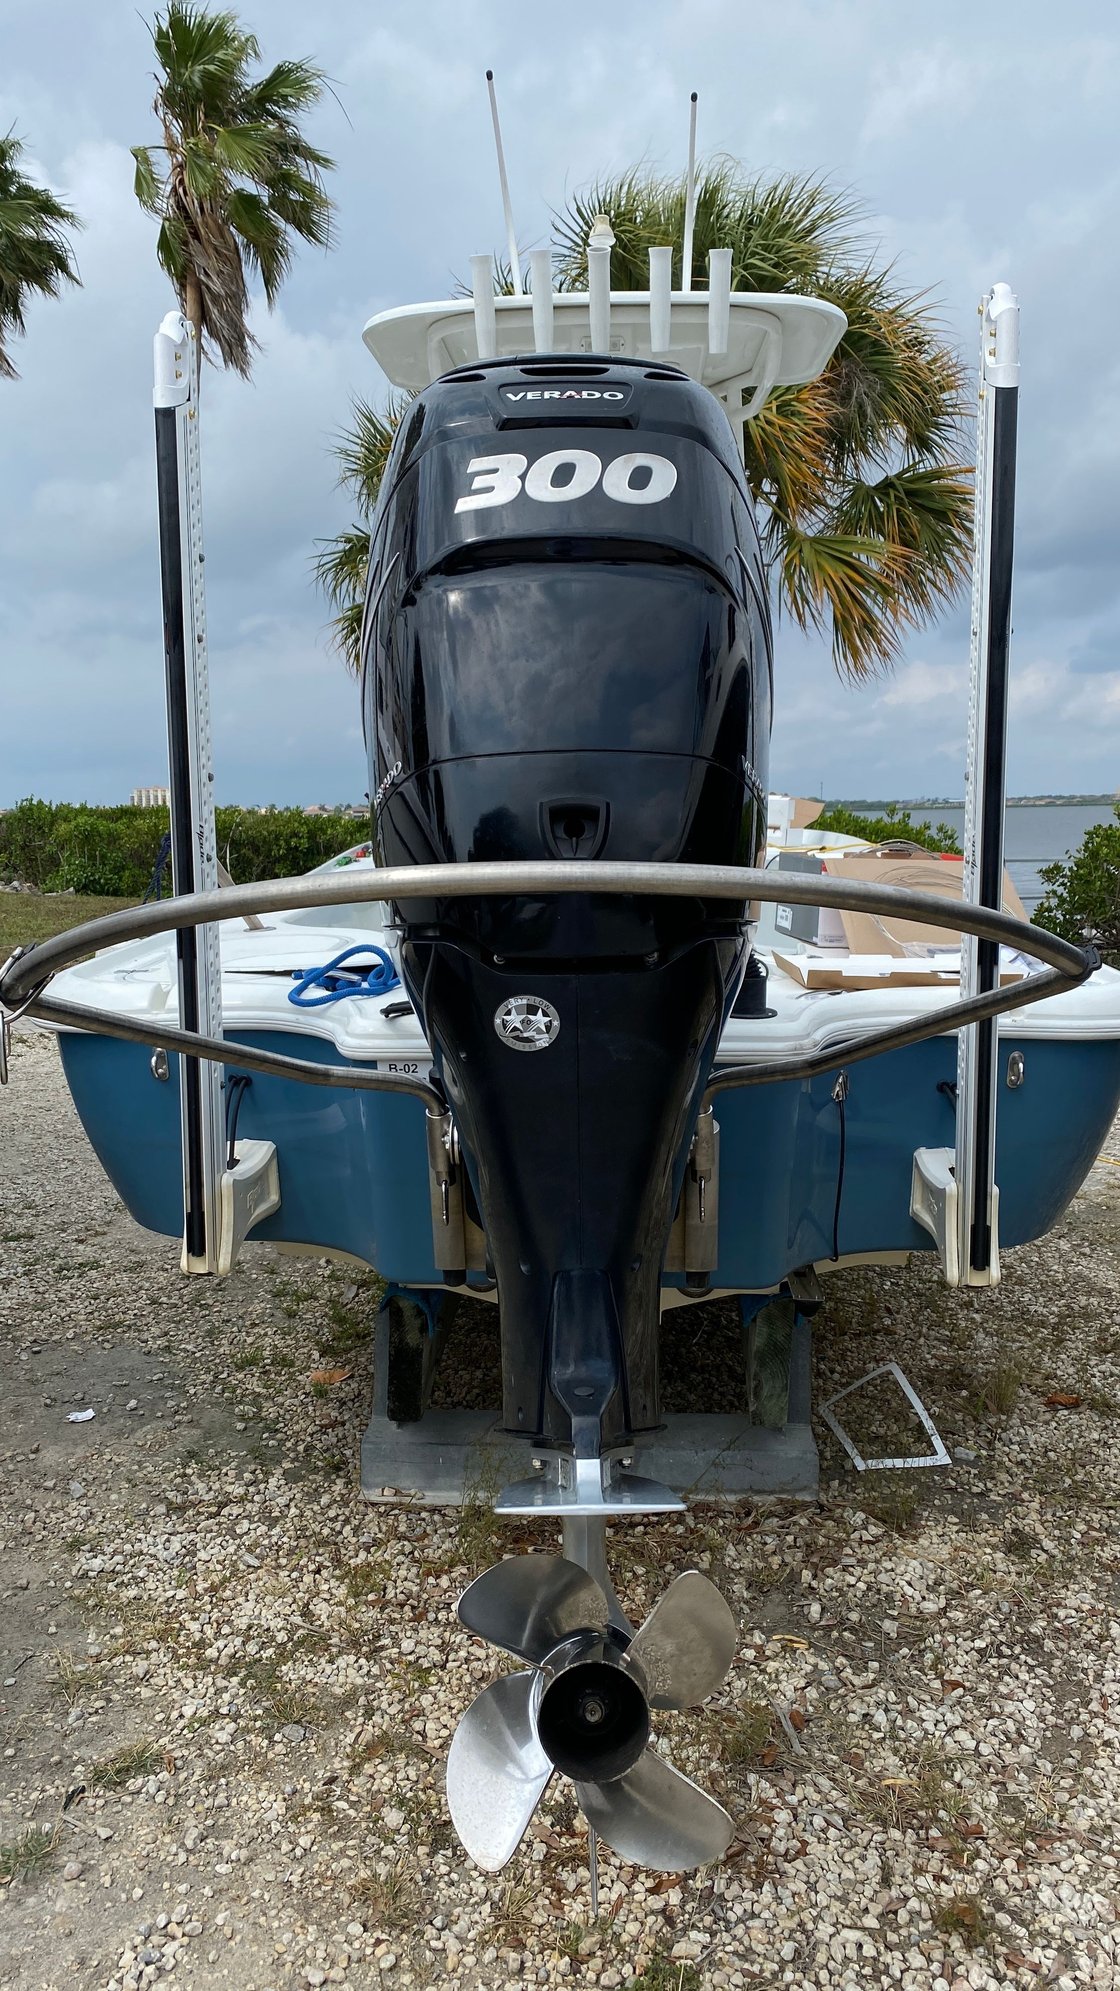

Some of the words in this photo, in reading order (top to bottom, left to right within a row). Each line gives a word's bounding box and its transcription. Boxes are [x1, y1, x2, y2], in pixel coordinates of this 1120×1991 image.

[506, 390, 624, 401] VERADO
[454, 449, 678, 514] 300
[503, 997, 525, 1009] VERY
[533, 998, 551, 1010] LOW
[388, 1063, 419, 1073] B-02
